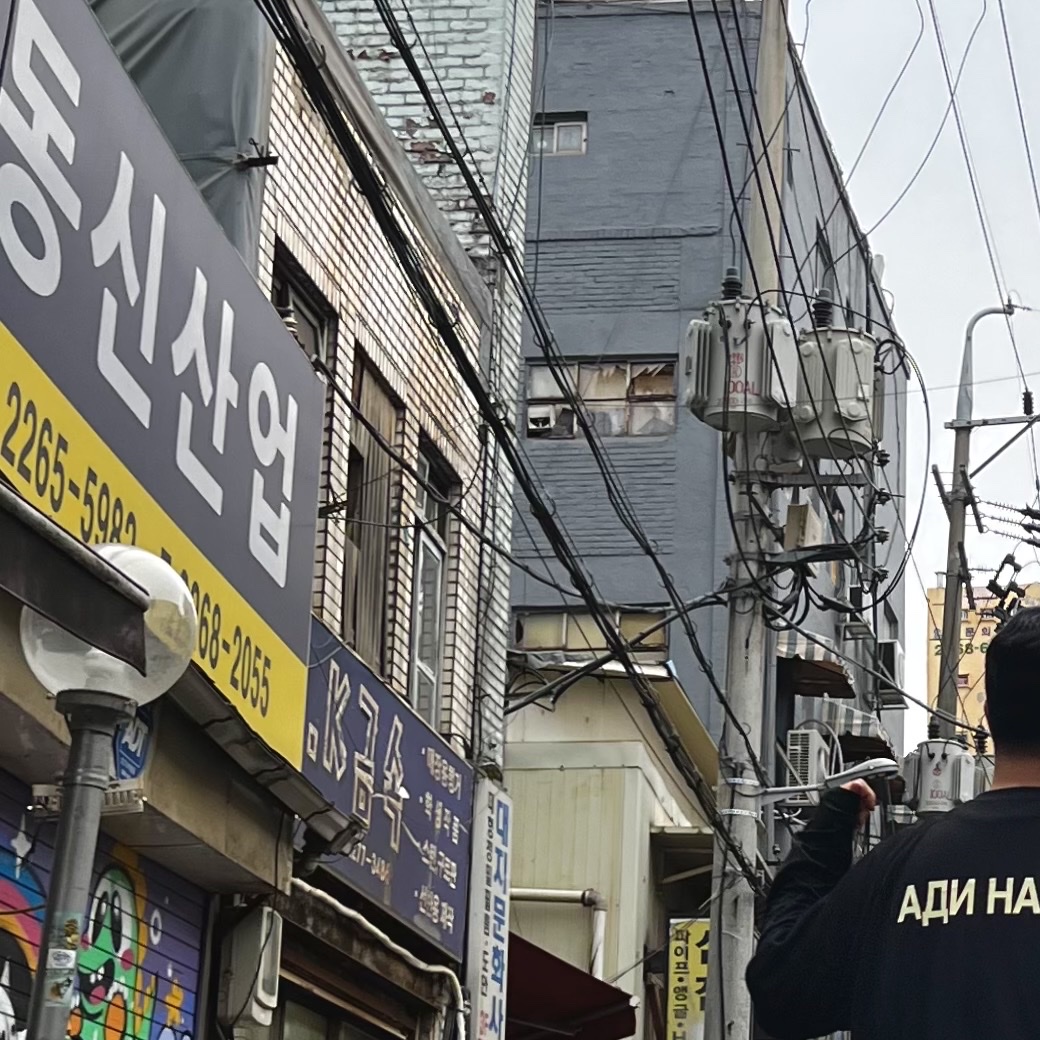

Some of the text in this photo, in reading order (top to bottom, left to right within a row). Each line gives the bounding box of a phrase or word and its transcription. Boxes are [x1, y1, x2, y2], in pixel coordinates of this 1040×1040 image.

[0, 0, 298, 588] 동신산업
[180, 569, 273, 718] 68-2055
[897, 877, 976, 927] АДИ
